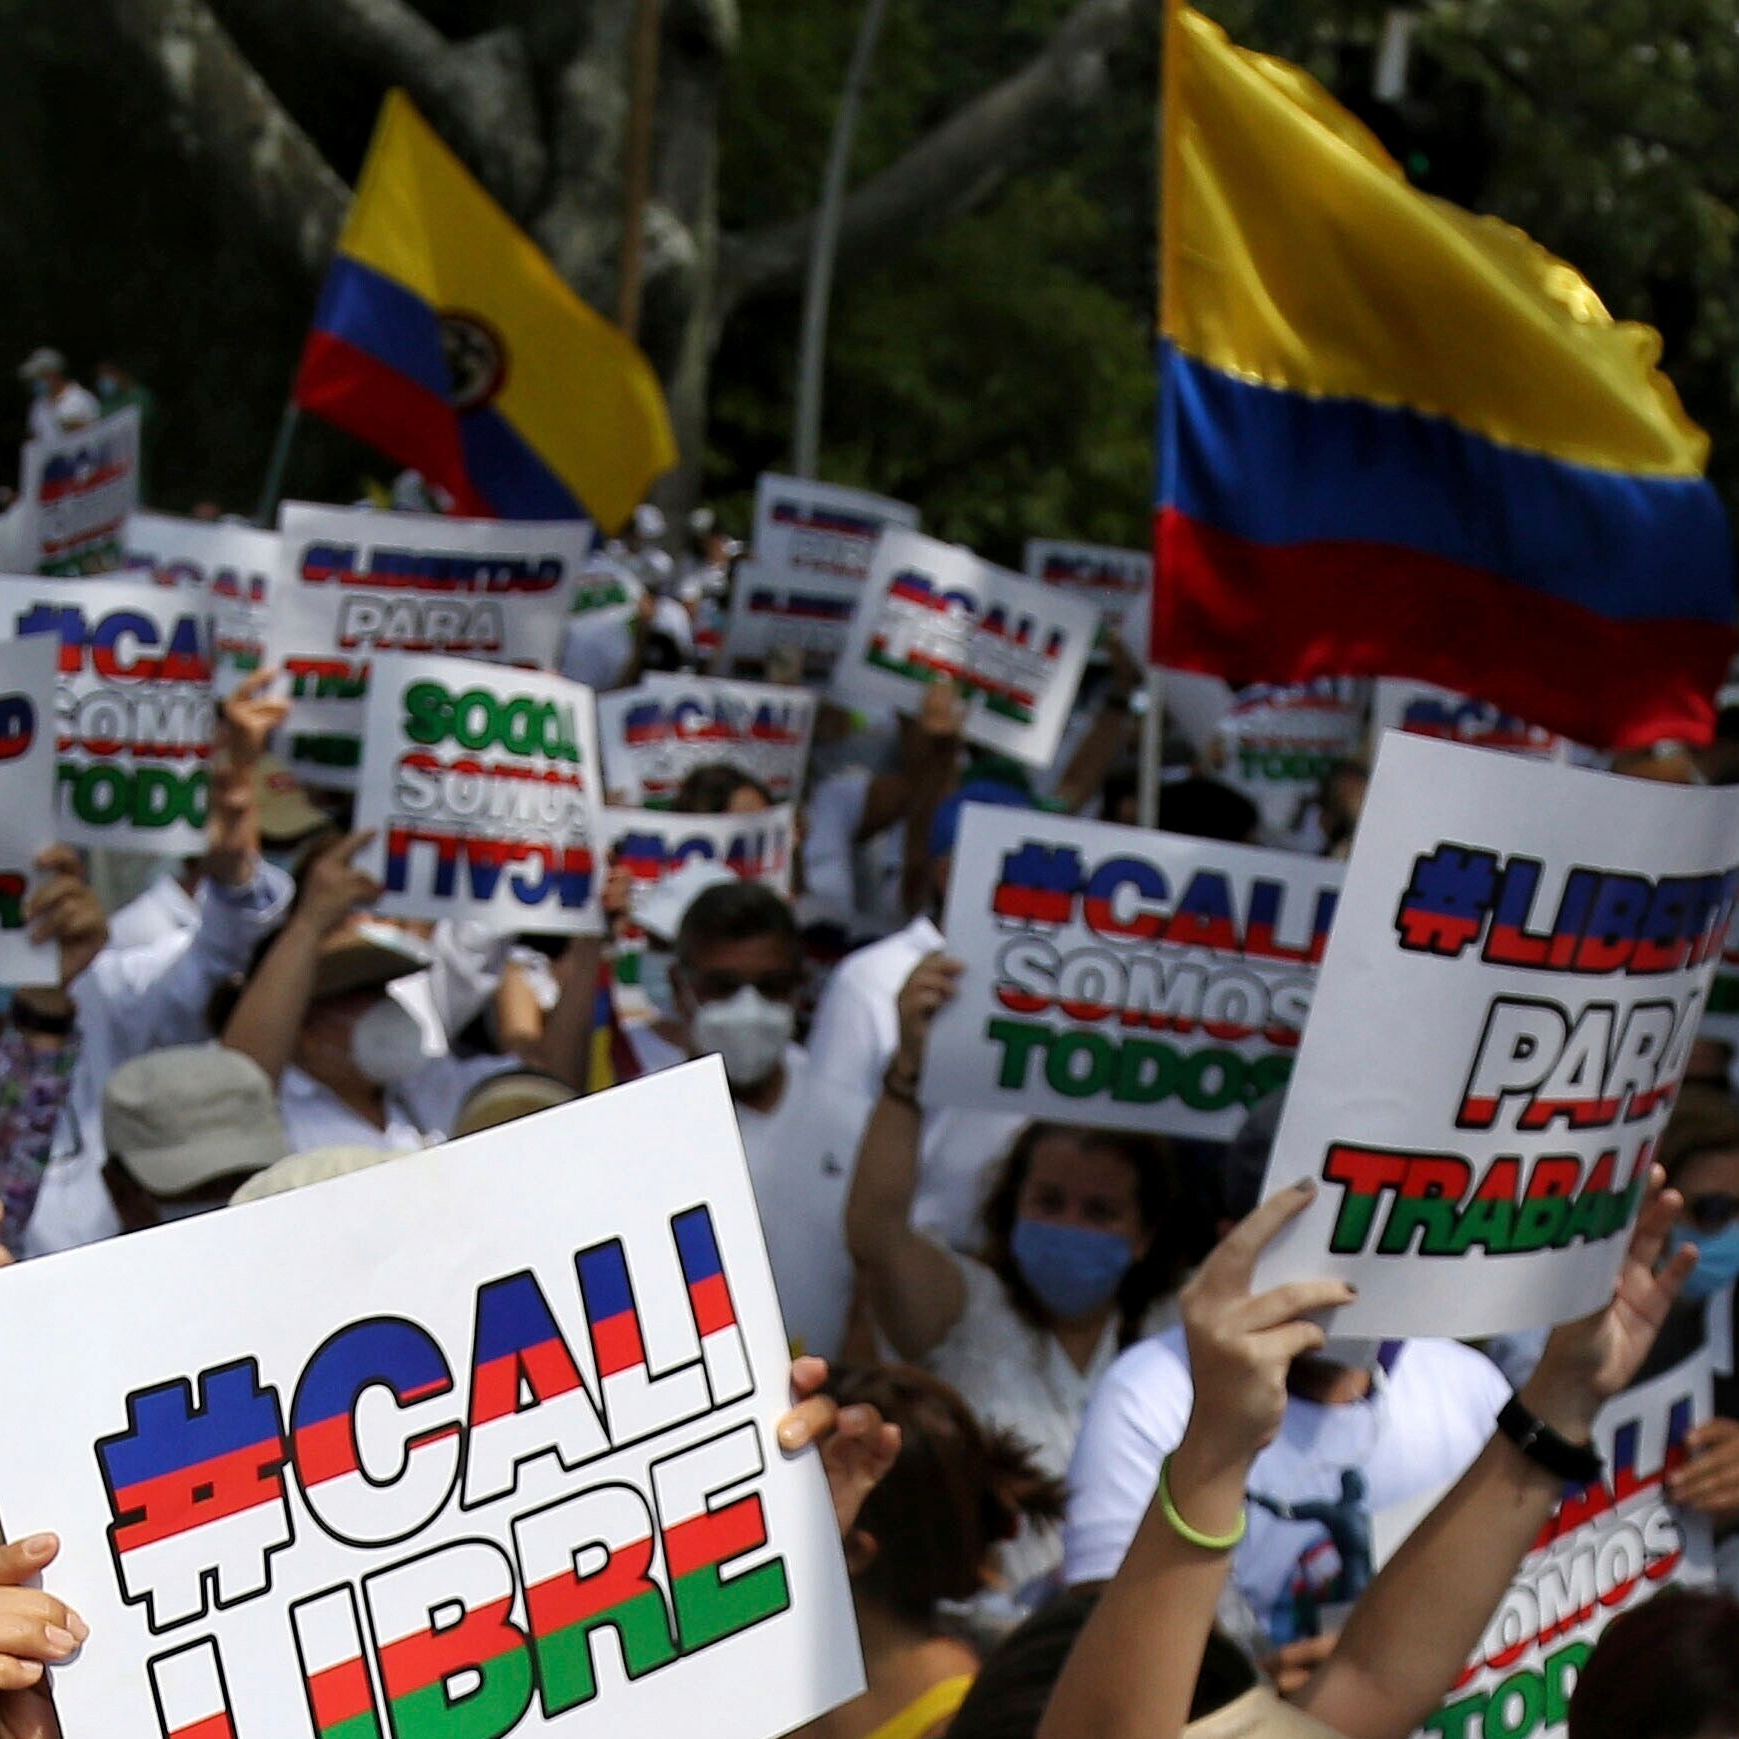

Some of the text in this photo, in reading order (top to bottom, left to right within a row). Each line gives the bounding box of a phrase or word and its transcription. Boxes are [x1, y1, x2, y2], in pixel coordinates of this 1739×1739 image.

[337, 597, 506, 654] PARA
[992, 840, 1342, 968] #CALI
[994, 935, 1320, 1048] SOMOS
[95, 1202, 755, 1636] #CALI
[1450, 1498, 1686, 1692] OMOS
